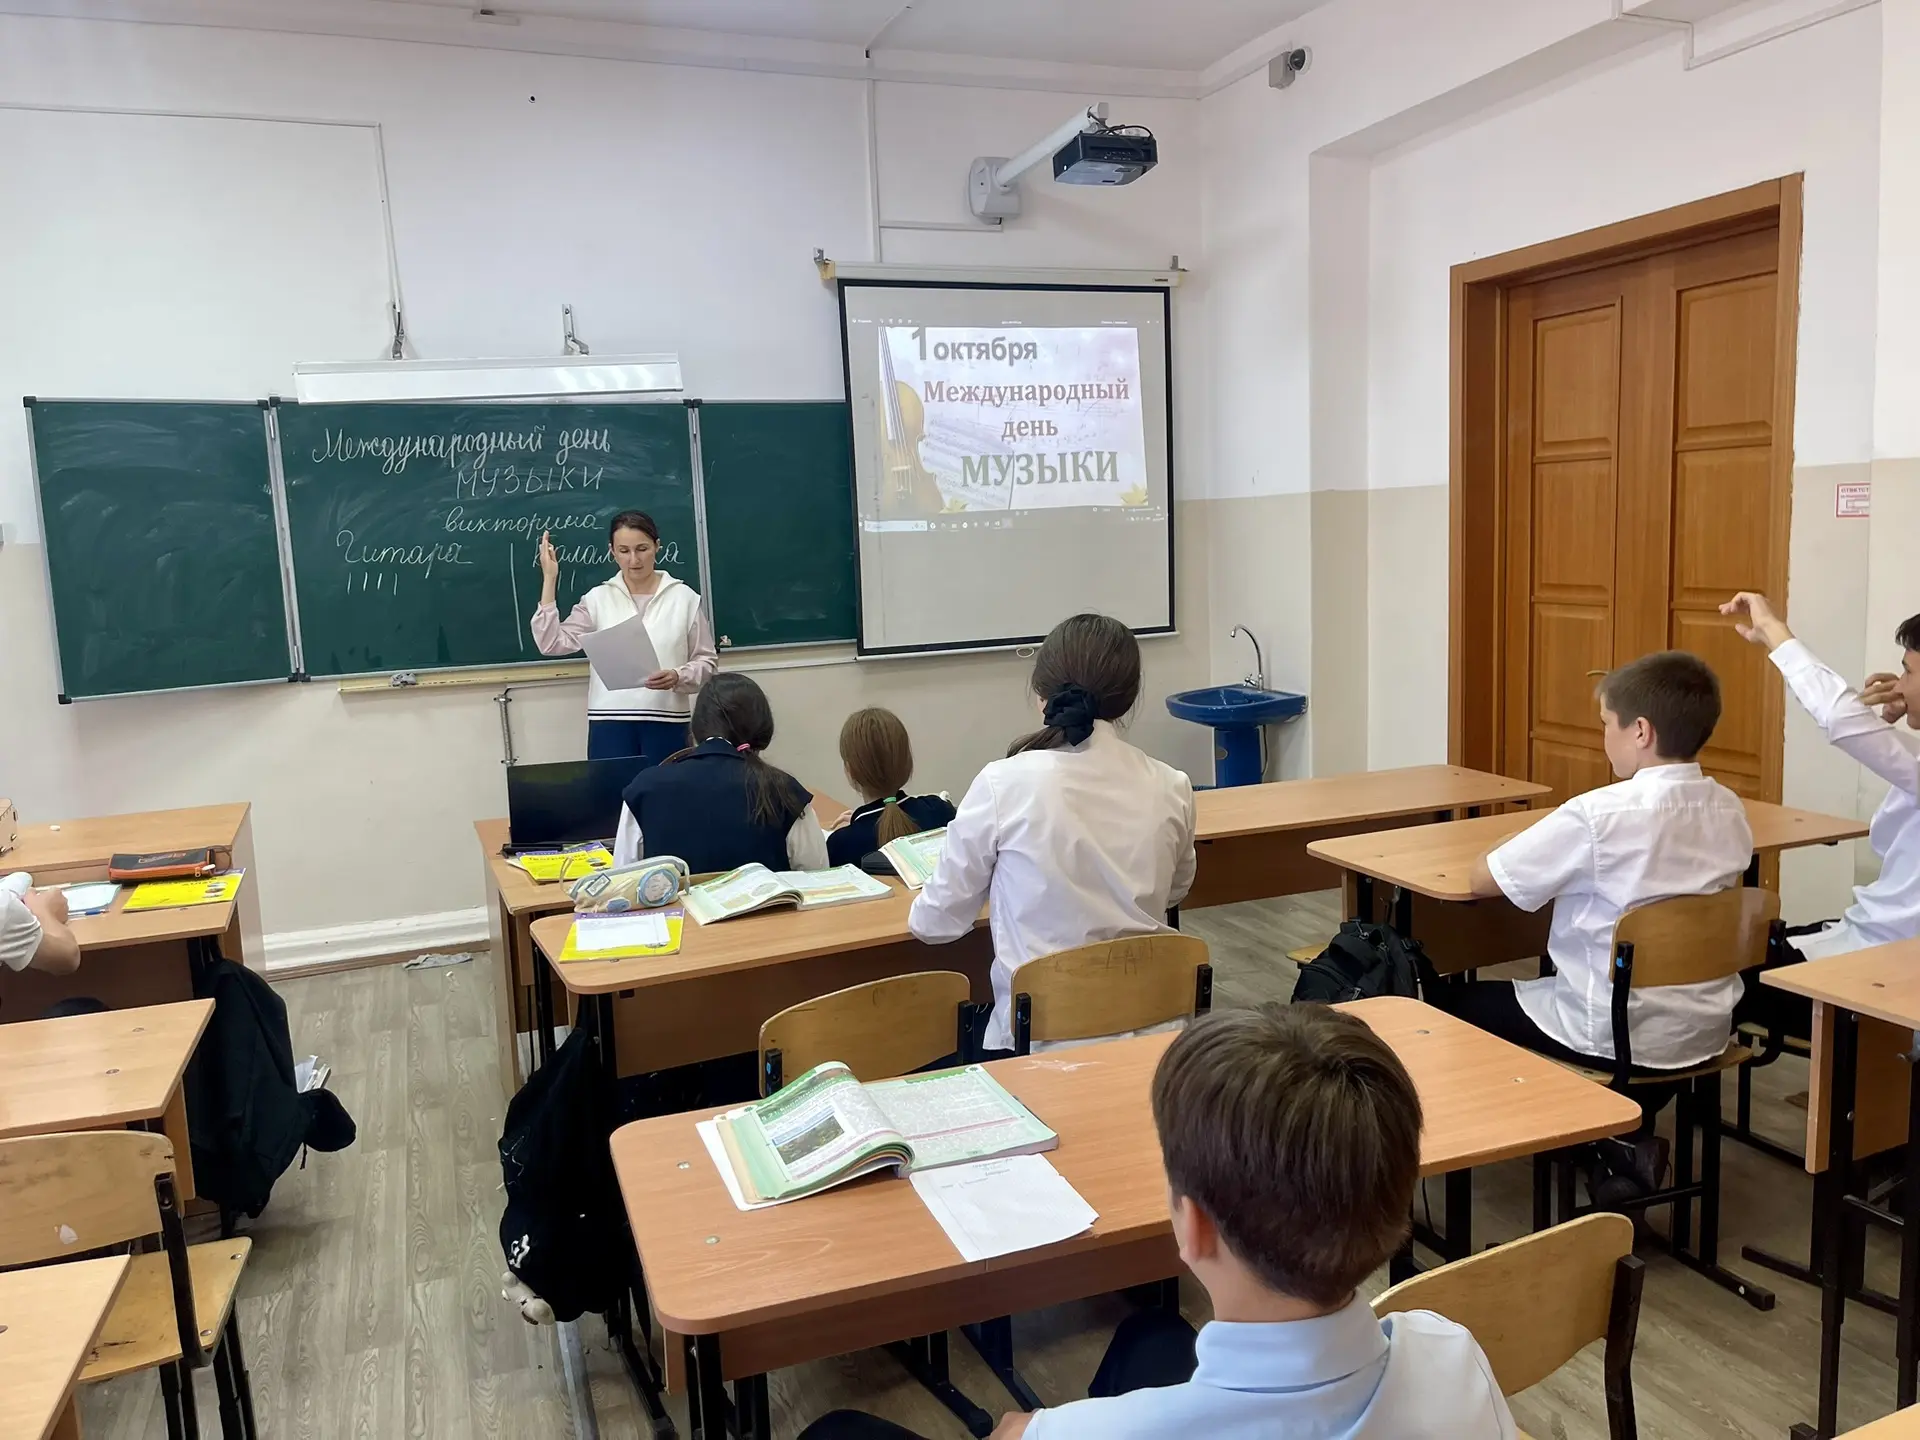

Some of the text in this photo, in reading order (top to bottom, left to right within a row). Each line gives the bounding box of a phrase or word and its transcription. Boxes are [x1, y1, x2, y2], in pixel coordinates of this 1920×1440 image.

[911, 327, 1037, 366] 1 октября
[923, 378, 1130, 408] Международный
[1001, 419, 1059, 441] день
[312, 424, 611, 475] Международный день
[456, 465, 604, 499] МУЗЫКИ
[961, 450, 1120, 488] МУЗЫКИ
[444, 506, 604, 541] викторина
[336, 530, 474, 579] Гитара
